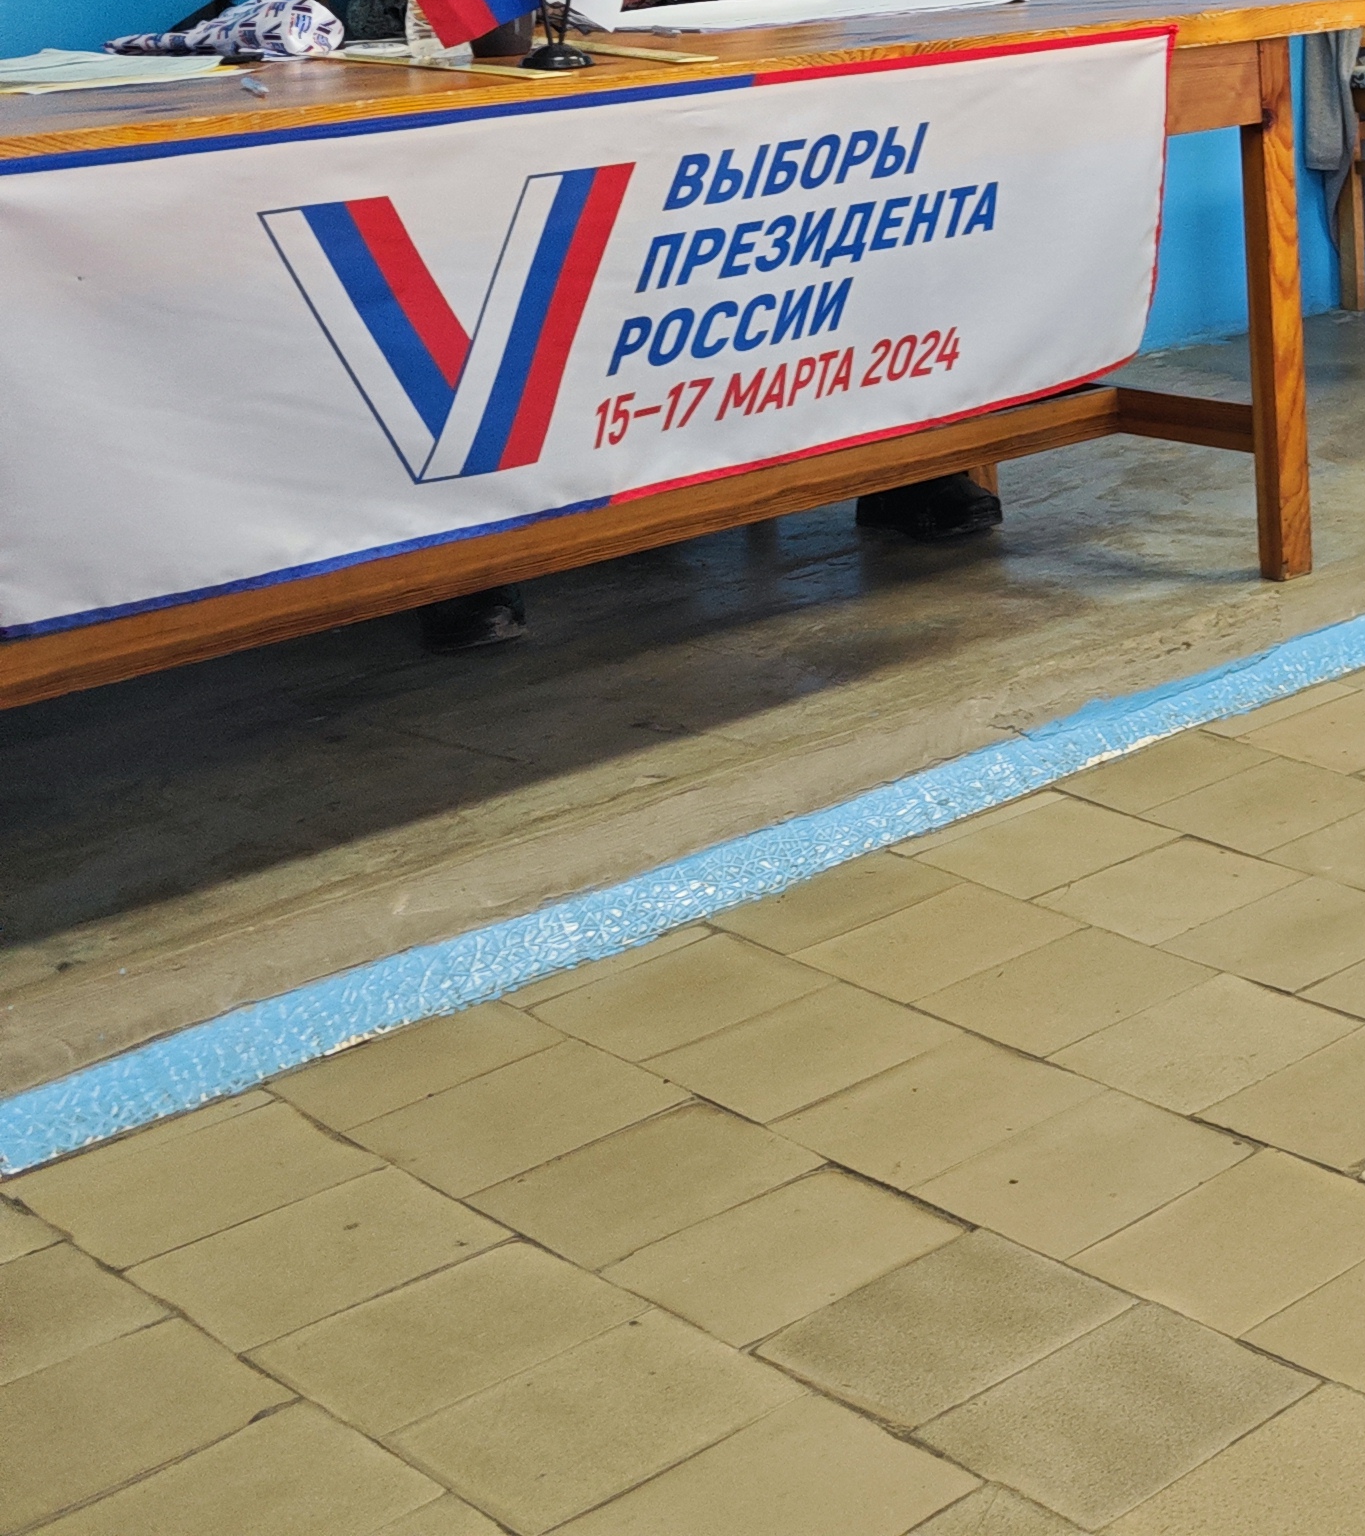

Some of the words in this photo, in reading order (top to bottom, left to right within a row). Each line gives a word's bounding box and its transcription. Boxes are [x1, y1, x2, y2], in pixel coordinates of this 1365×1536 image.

[662, 121, 931, 212] ВЫБОРЫ
[634, 180, 1000, 294] ПРЕЗИДЕНТА
[606, 276, 854, 378] РОССИИ
[714, 345, 855, 422] МАРТА
[860, 326, 962, 389] 2024
